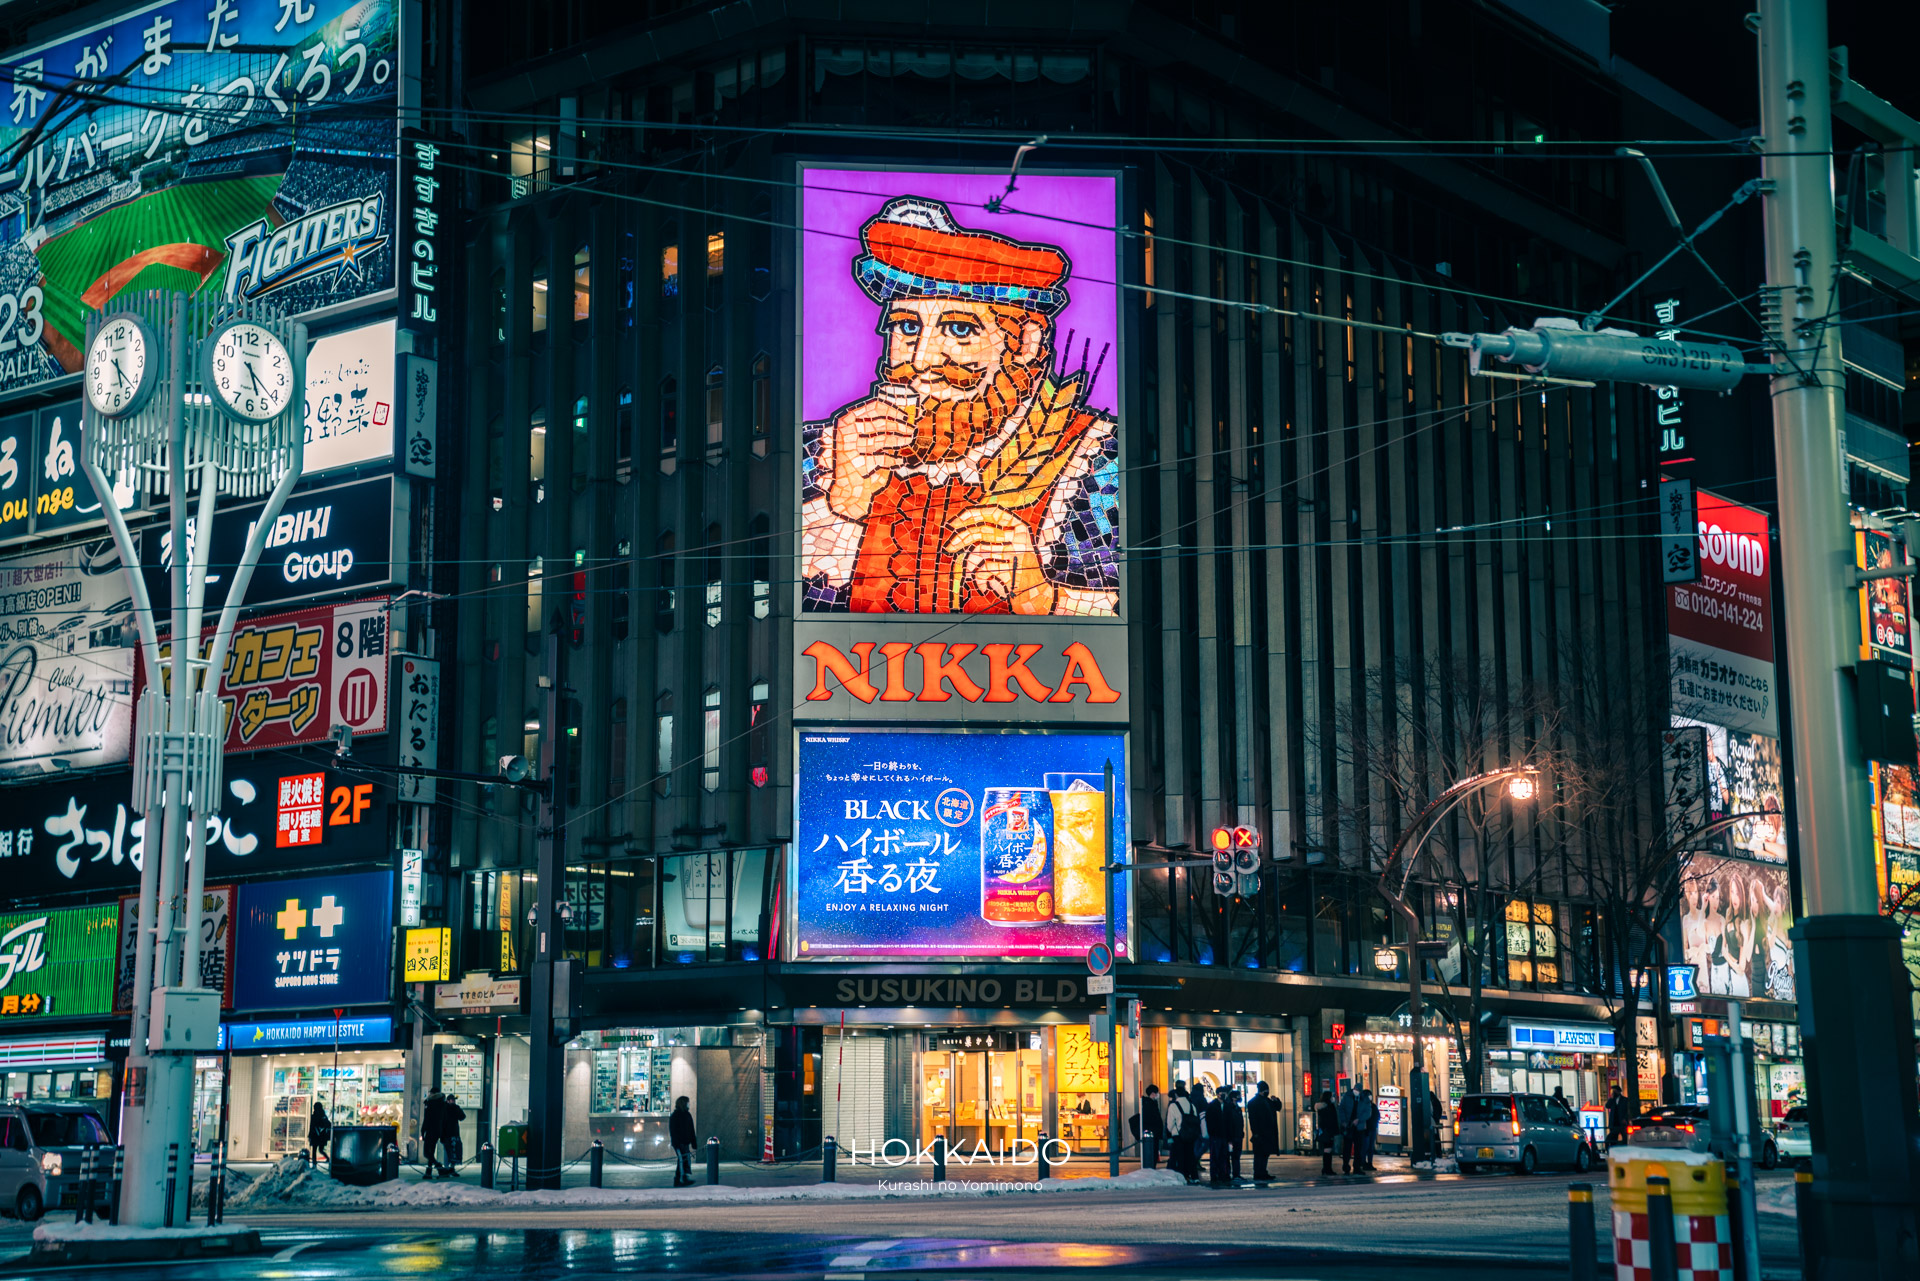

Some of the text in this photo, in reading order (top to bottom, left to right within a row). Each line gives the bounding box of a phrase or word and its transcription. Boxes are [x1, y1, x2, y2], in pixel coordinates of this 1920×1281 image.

[411, 141, 441, 322] すすきのビル
[225, 195, 386, 302] FIGHTERS
[114, 326, 125, 340] 12
[128, 329, 133, 342] 1
[231, 333, 243, 347] 11
[245, 332, 259, 346] 12
[104, 335, 113, 348] 11
[134, 339, 141, 352] 2
[263, 342, 270, 354] 1
[96, 349, 107, 362] 10
[220, 343, 235, 358] 10
[137, 356, 143, 368] 3
[217, 358, 226, 371] 9
[272, 356, 281, 368] 2
[93, 366, 100, 379] 9
[132, 373, 138, 385] 4
[276, 373, 285, 386] 3
[96, 382, 103, 395] 8
[221, 376, 230, 389] 8
[105, 392, 111, 405] 7
[124, 386, 131, 399] 5
[232, 391, 242, 404] 7
[270, 389, 279, 401] 4
[114, 394, 120, 407] 6
[246, 398, 254, 412] 6
[260, 397, 269, 411] 5
[409, 430, 434, 466] 空
[1698, 521, 1764, 577] SOUND
[283, 548, 353, 584] Group
[1691, 591, 1763, 633] 0120-141-224
[336, 616, 385, 659] 8階
[48, 665, 76, 692] Club
[801, 640, 1121, 703] NIKKA
[1729, 739, 1758, 762] Royal
[863, 761, 923, 771] 一日の終わりを、
[826, 772, 953, 783] ちょっと幸せにしてくれるハイボール。
[280, 776, 323, 807] 炭火焼き
[1735, 780, 1756, 801] Club
[329, 783, 373, 826] 2F
[844, 799, 931, 820] BLACK
[942, 796, 969, 810] 北海道
[943, 808, 964, 821] 限定
[812, 827, 962, 857] ハイボール
[992, 842, 1046, 854] ハイボール
[998, 854, 1038, 869] 香る夜
[833, 858, 942, 894] 香る夜
[826, 903, 949, 912] ENJOY A RELAXING NIGHT
[276, 948, 340, 974] サツドラ
[406, 956, 439, 972] 四文屋
[275, 973, 339, 988] SAPPORO DRUG STORE
[458, 990, 495, 1001] すすきのビル
[836, 978, 1086, 1002] SUSUKINO BLD.
[1682, 1003, 1695, 1011] ATM
[266, 1027, 302, 1041] HOKKAIDO
[304, 1025, 326, 1038] HAPPY
[1558, 1031, 1596, 1045] LAWSON
[1064, 1032, 1080, 1087] スクエア
